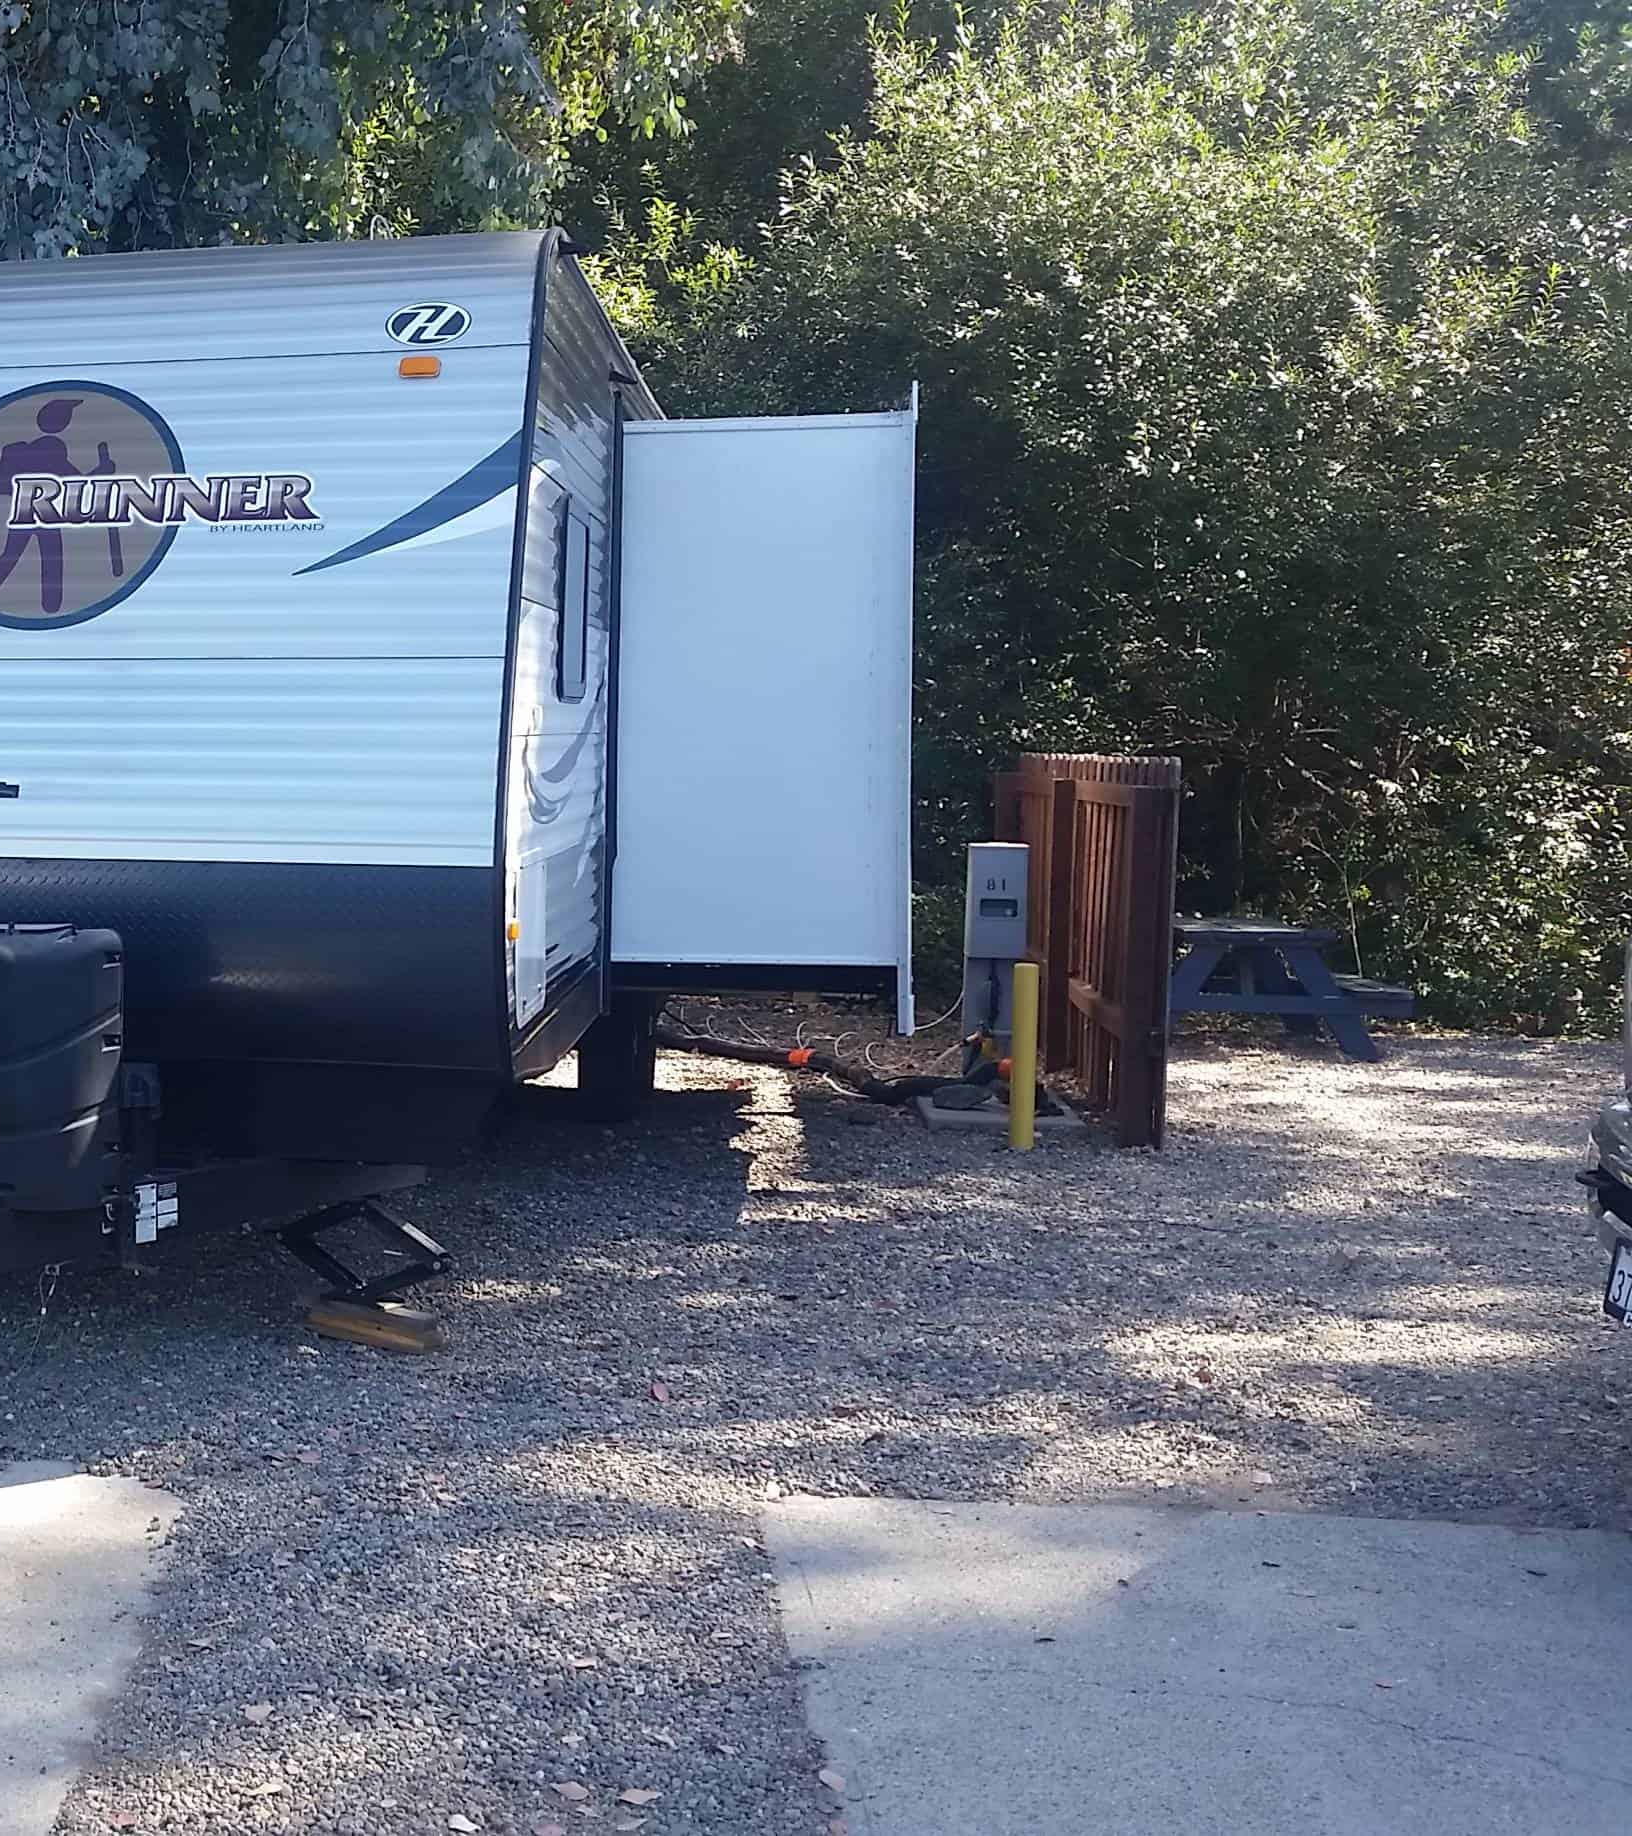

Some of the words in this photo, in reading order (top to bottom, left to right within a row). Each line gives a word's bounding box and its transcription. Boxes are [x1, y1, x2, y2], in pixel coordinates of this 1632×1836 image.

[9, 474, 321, 526] RUNNER
[209, 524, 228, 534] BY
[232, 523, 325, 533] HEARTLAND
